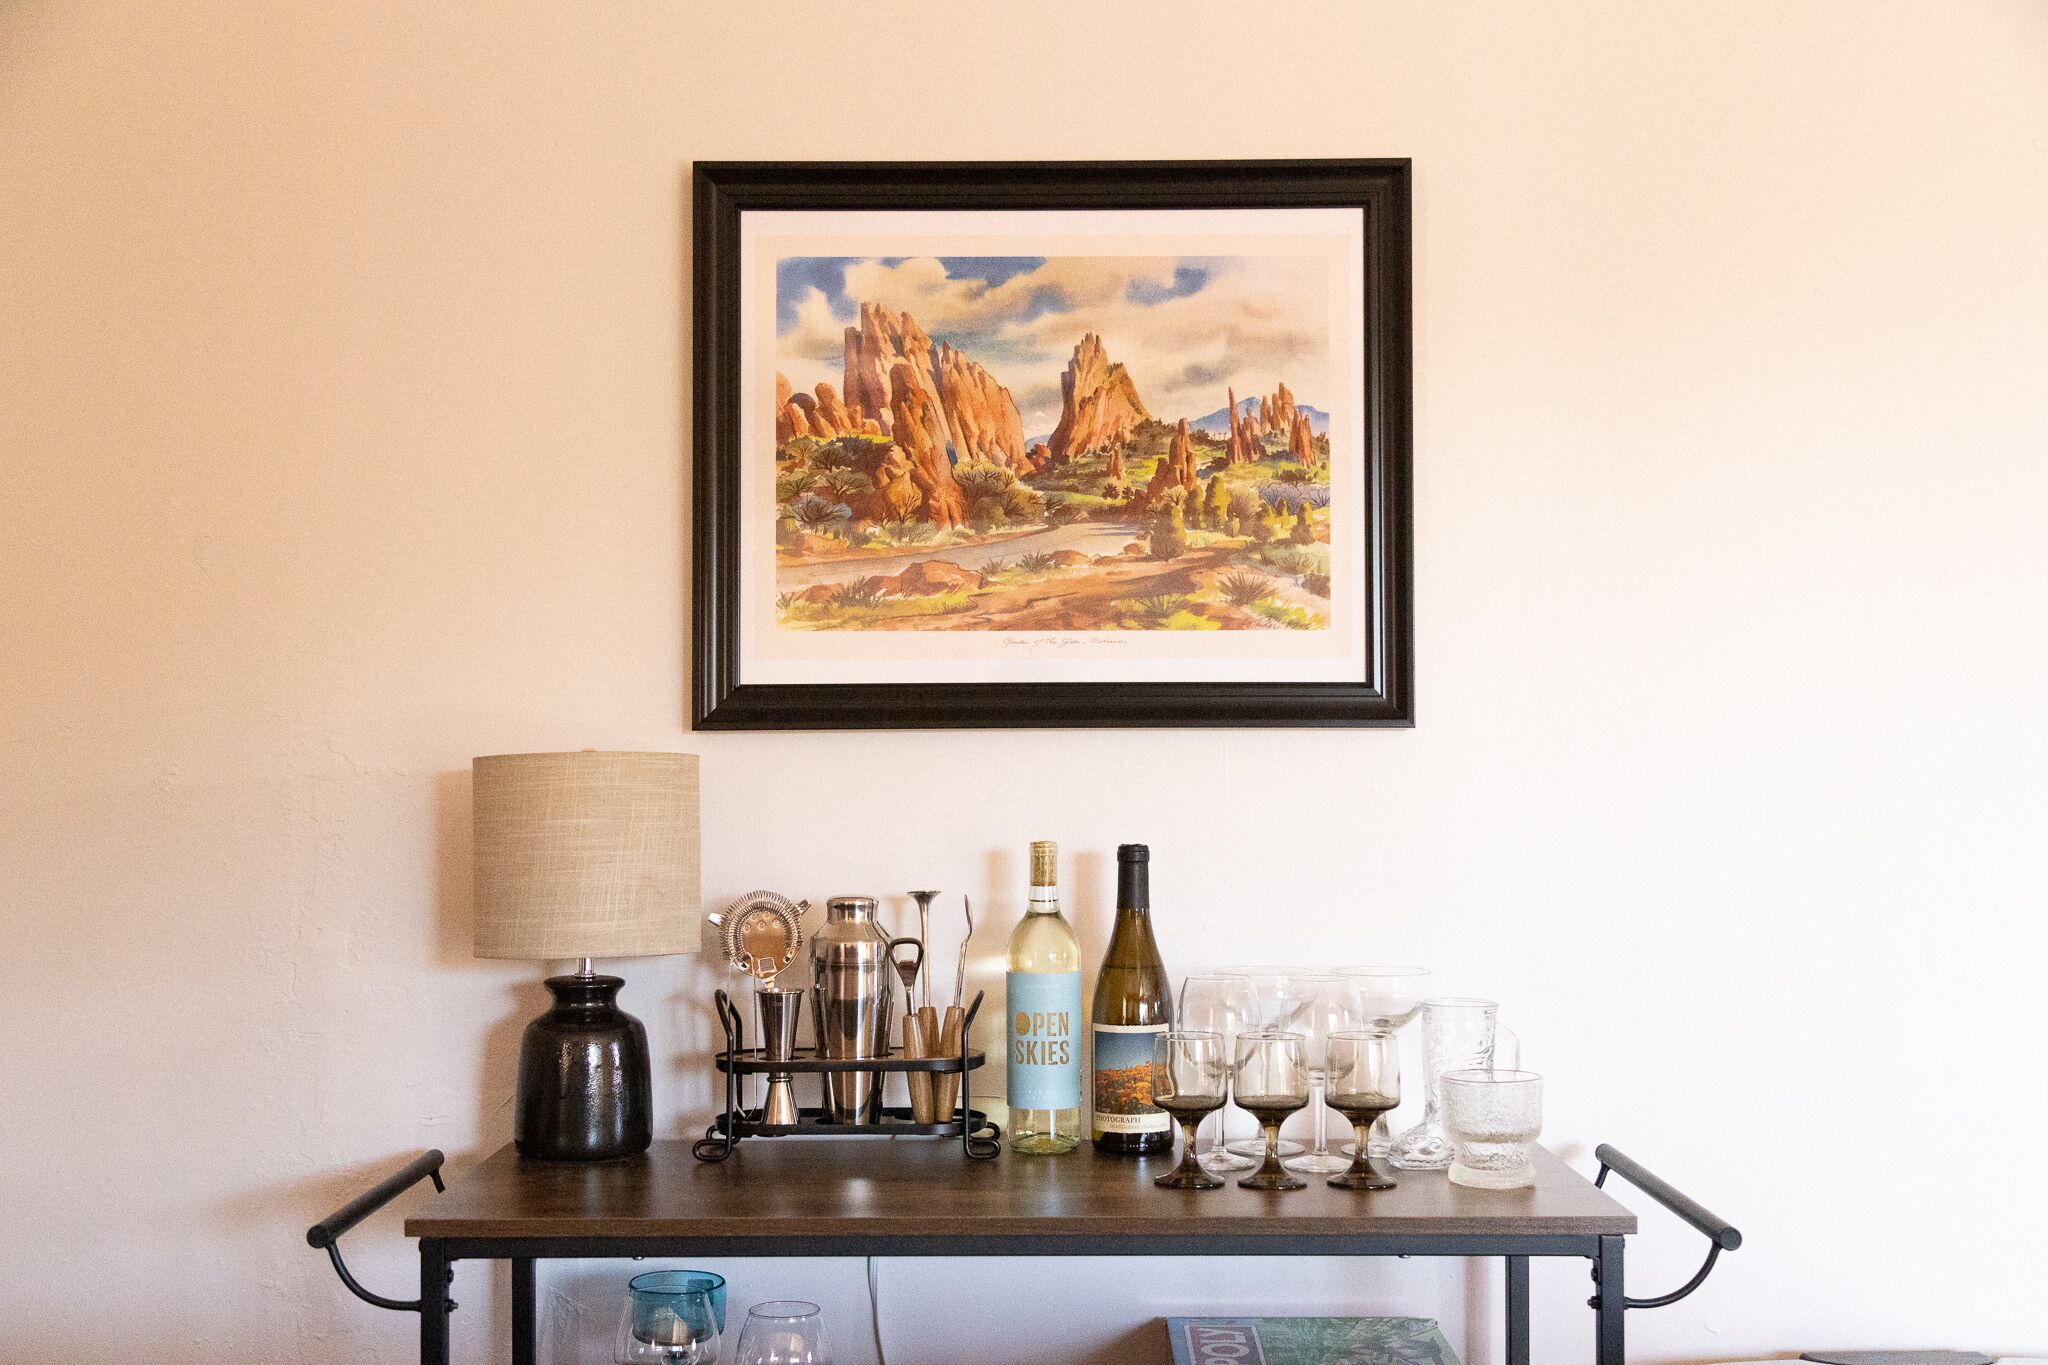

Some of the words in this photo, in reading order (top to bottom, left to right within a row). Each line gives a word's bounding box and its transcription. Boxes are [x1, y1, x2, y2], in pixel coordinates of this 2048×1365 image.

[1014, 1011, 1069, 1037] OPEN
[1014, 1040, 1070, 1066] SKIES
[1096, 1114, 1141, 1124] PHOTOGRAPH
